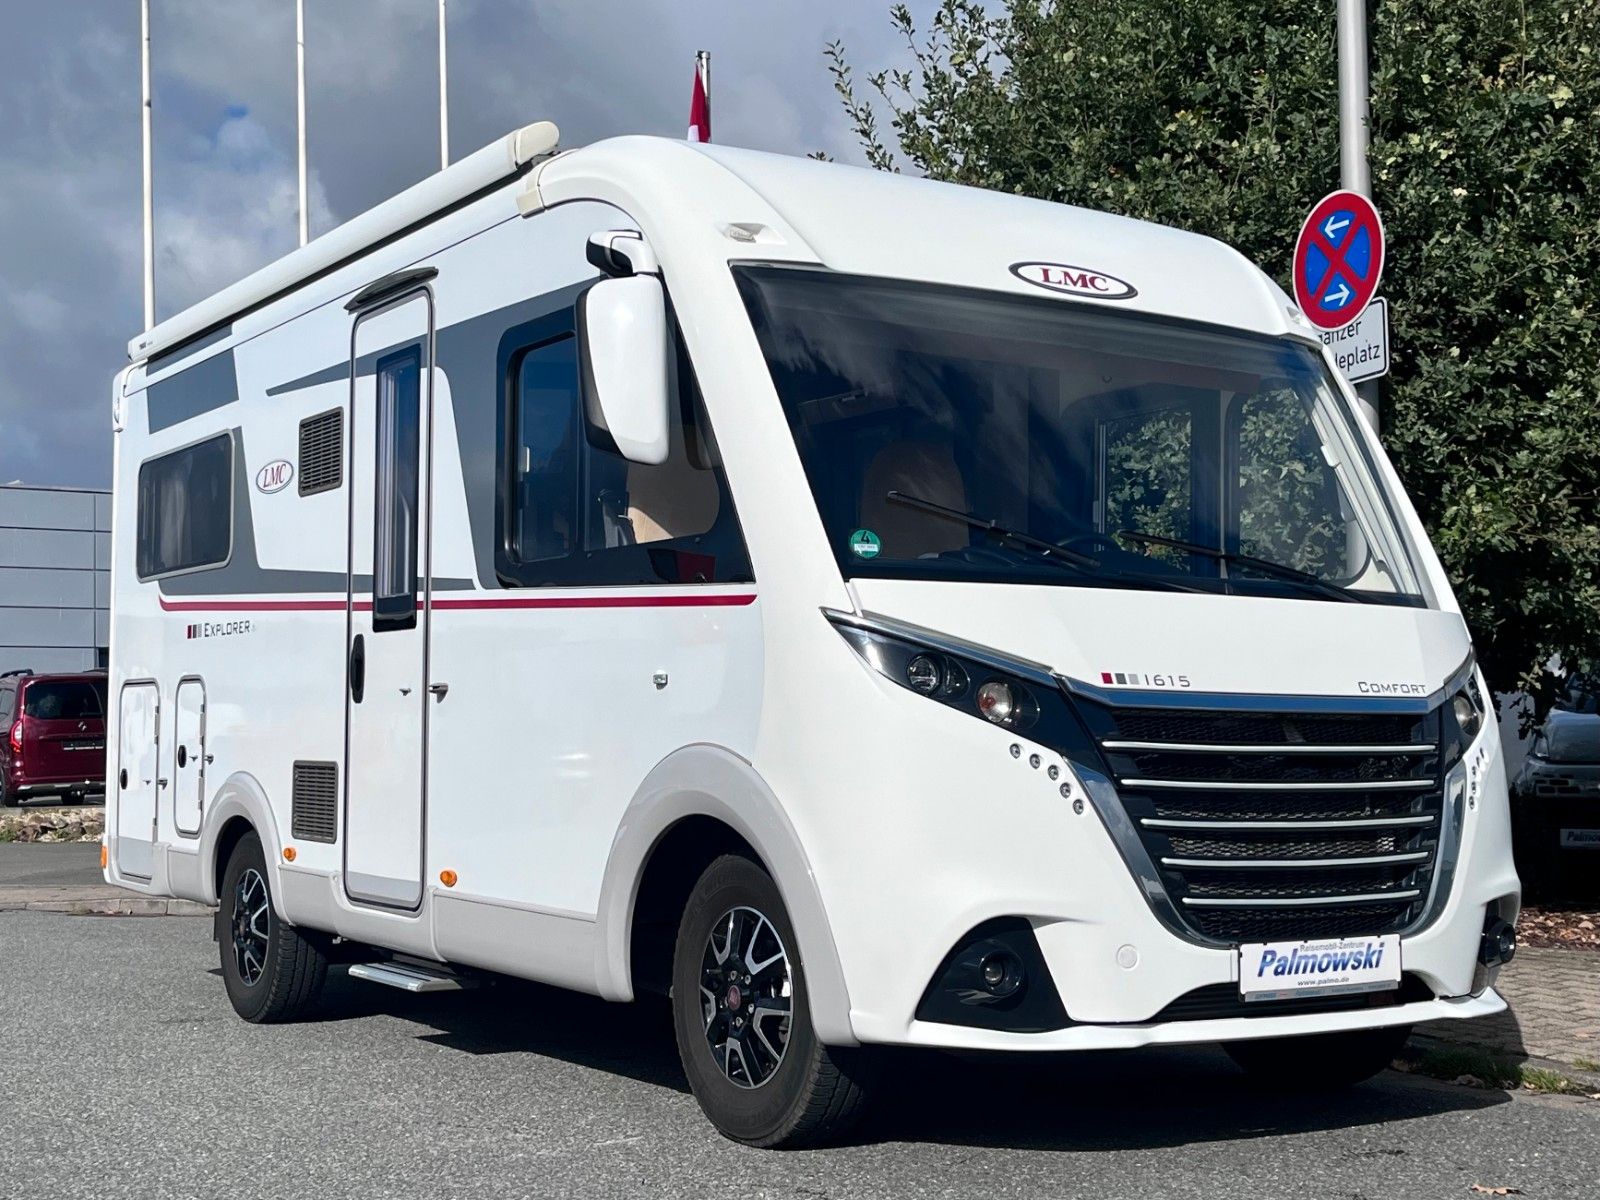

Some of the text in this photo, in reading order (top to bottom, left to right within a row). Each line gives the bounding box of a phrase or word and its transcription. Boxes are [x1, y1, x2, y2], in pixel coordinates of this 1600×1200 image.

[1040, 267, 1110, 292] LMC
[1318, 321, 1362, 345] anzer
[263, 463, 287, 488] LMC
[860, 530, 871, 545] 4
[1257, 942, 1385, 978] Palmowski
